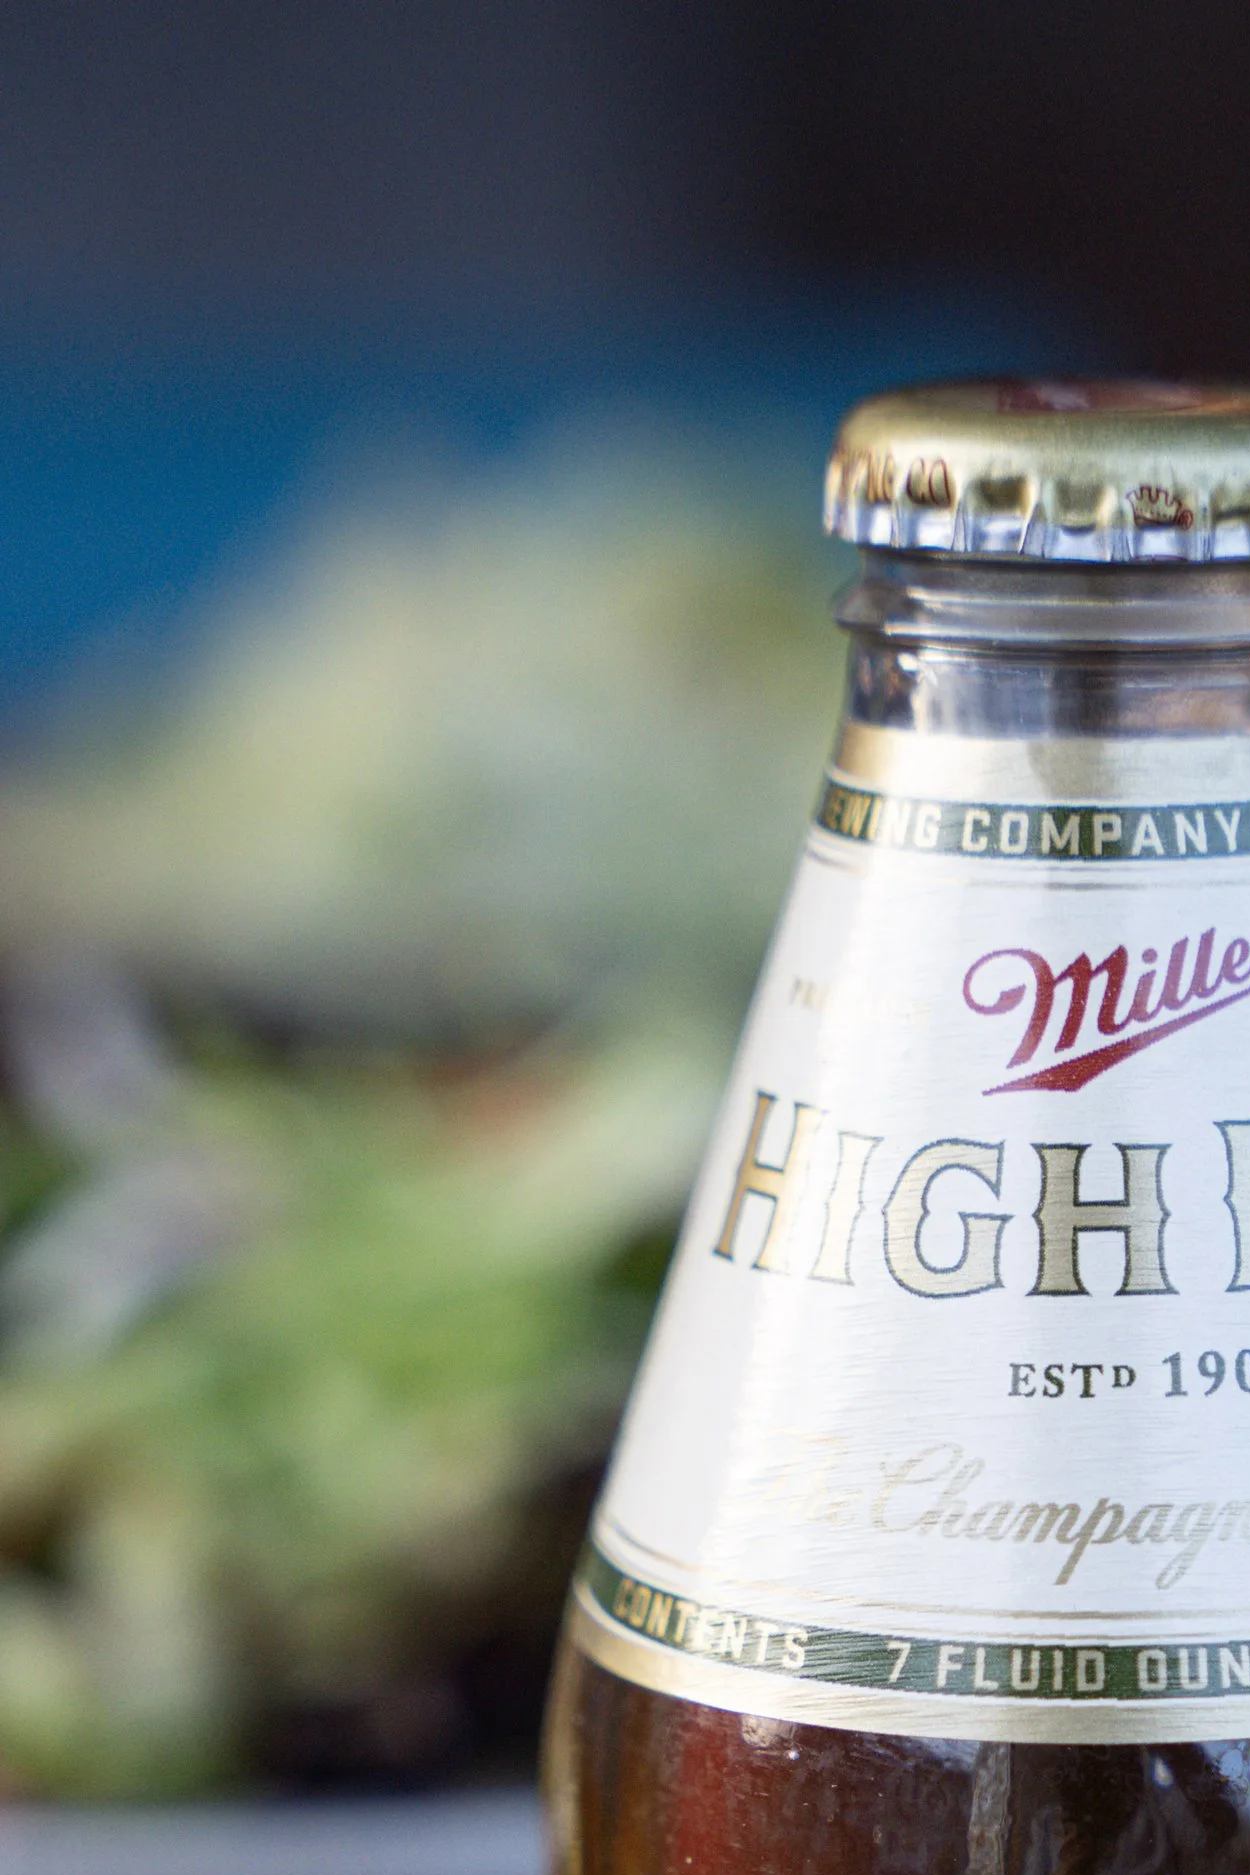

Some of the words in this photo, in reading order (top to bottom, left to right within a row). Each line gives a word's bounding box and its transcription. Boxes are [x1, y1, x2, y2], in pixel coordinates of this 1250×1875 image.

[962, 806, 1242, 856] COMPANY
[712, 1088, 1179, 1299] HIGH
[612, 1576, 809, 1670] CONTENTS
[884, 1640, 913, 1684] 7
[934, 1644, 1106, 1693] FLUID
